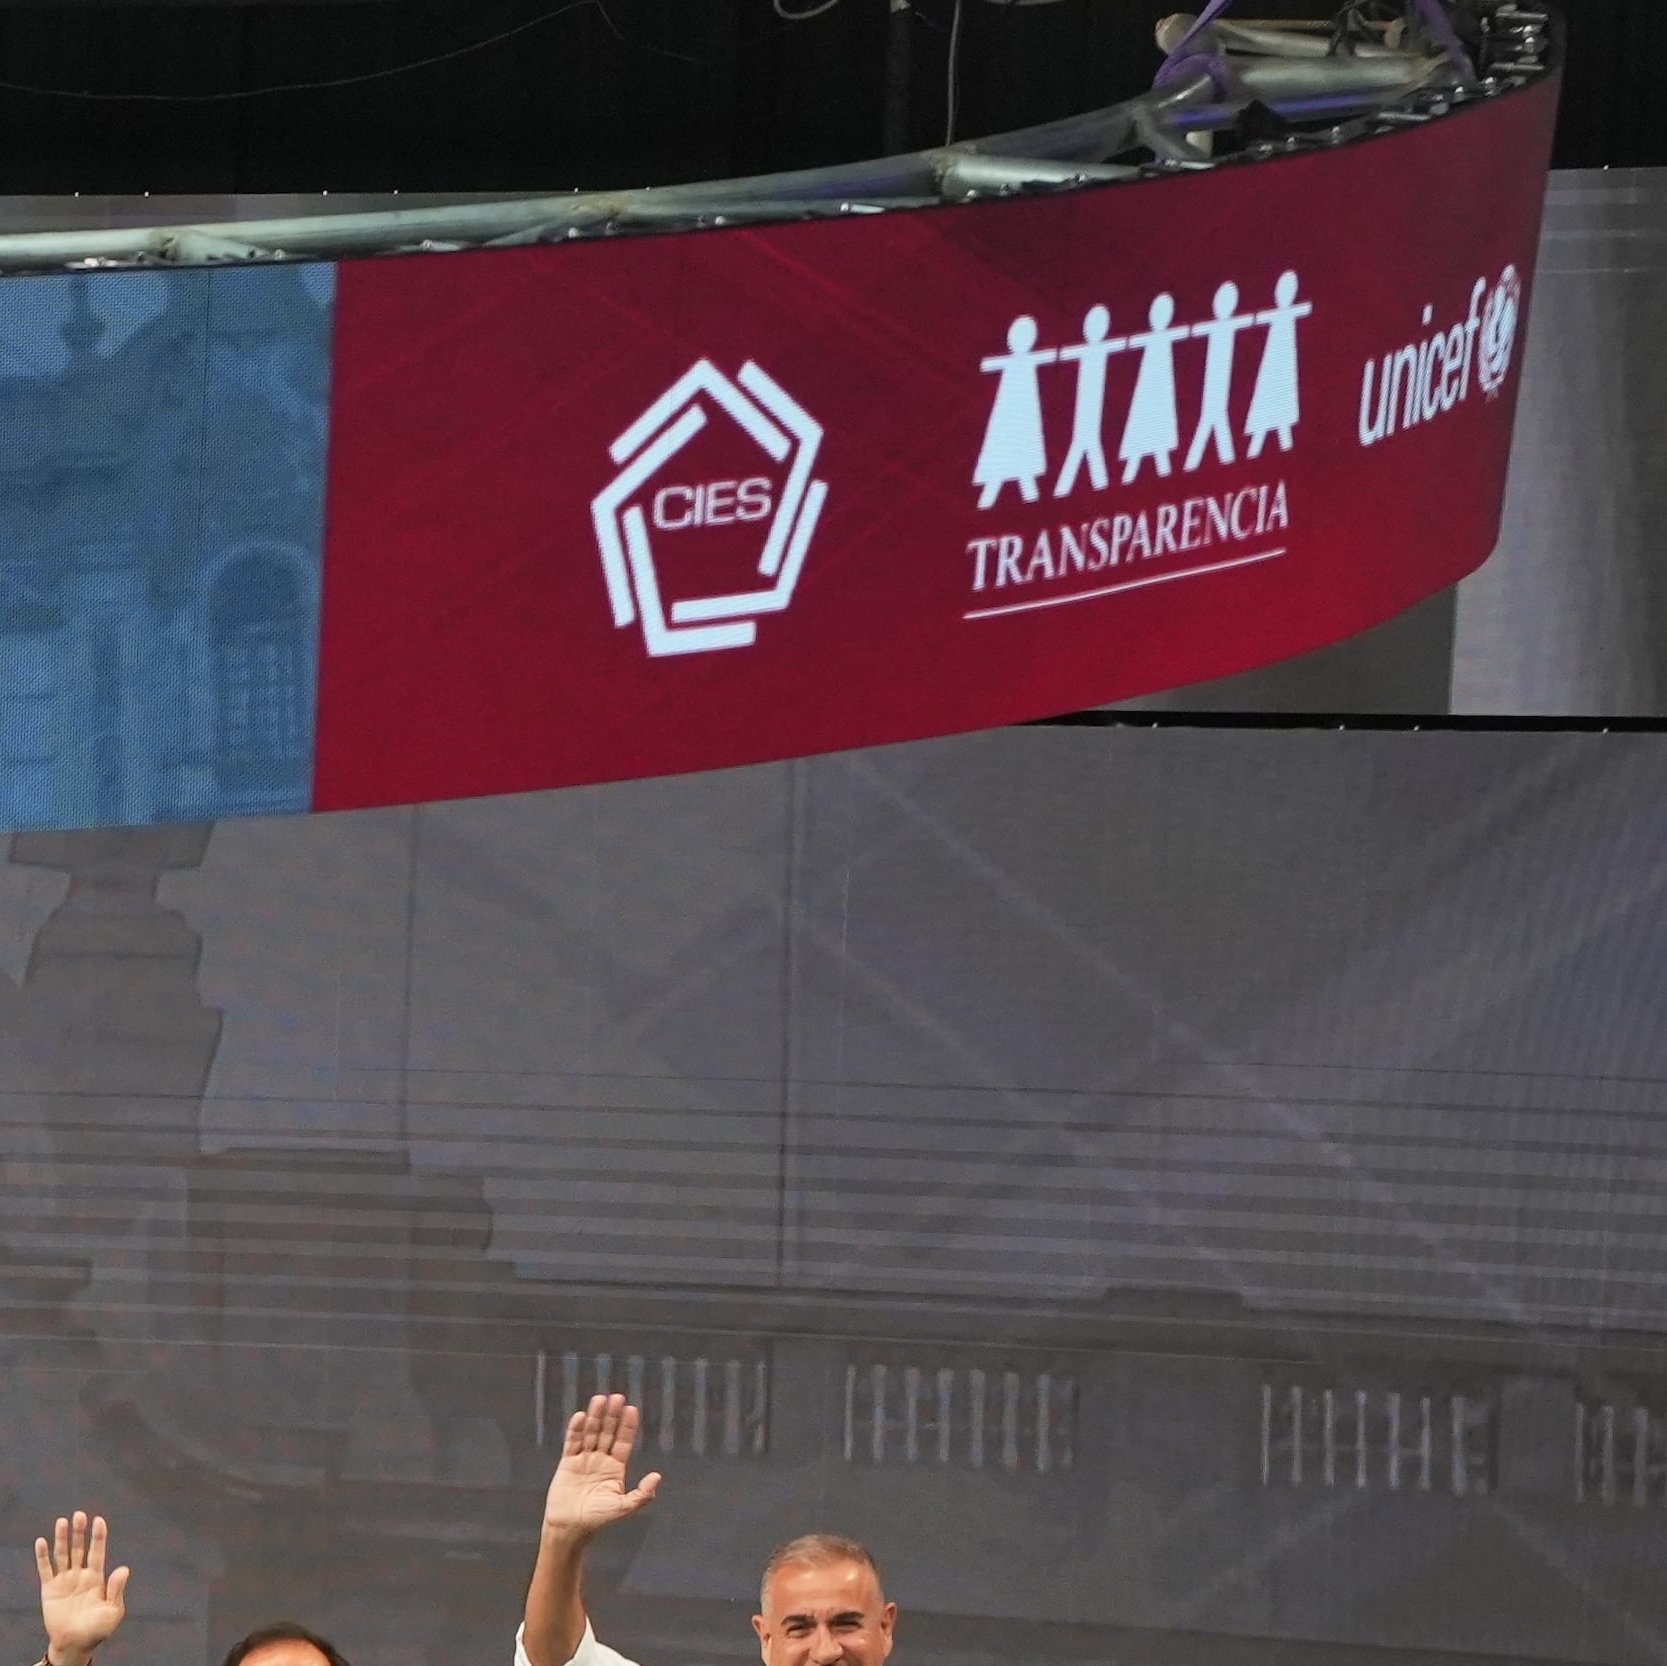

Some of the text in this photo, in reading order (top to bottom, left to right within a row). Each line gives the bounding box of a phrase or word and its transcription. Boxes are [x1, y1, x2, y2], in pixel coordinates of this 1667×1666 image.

[1358, 275, 1488, 447] unicef
[653, 477, 772, 531] CIES
[966, 480, 1289, 592] TRANSPARENCIA
